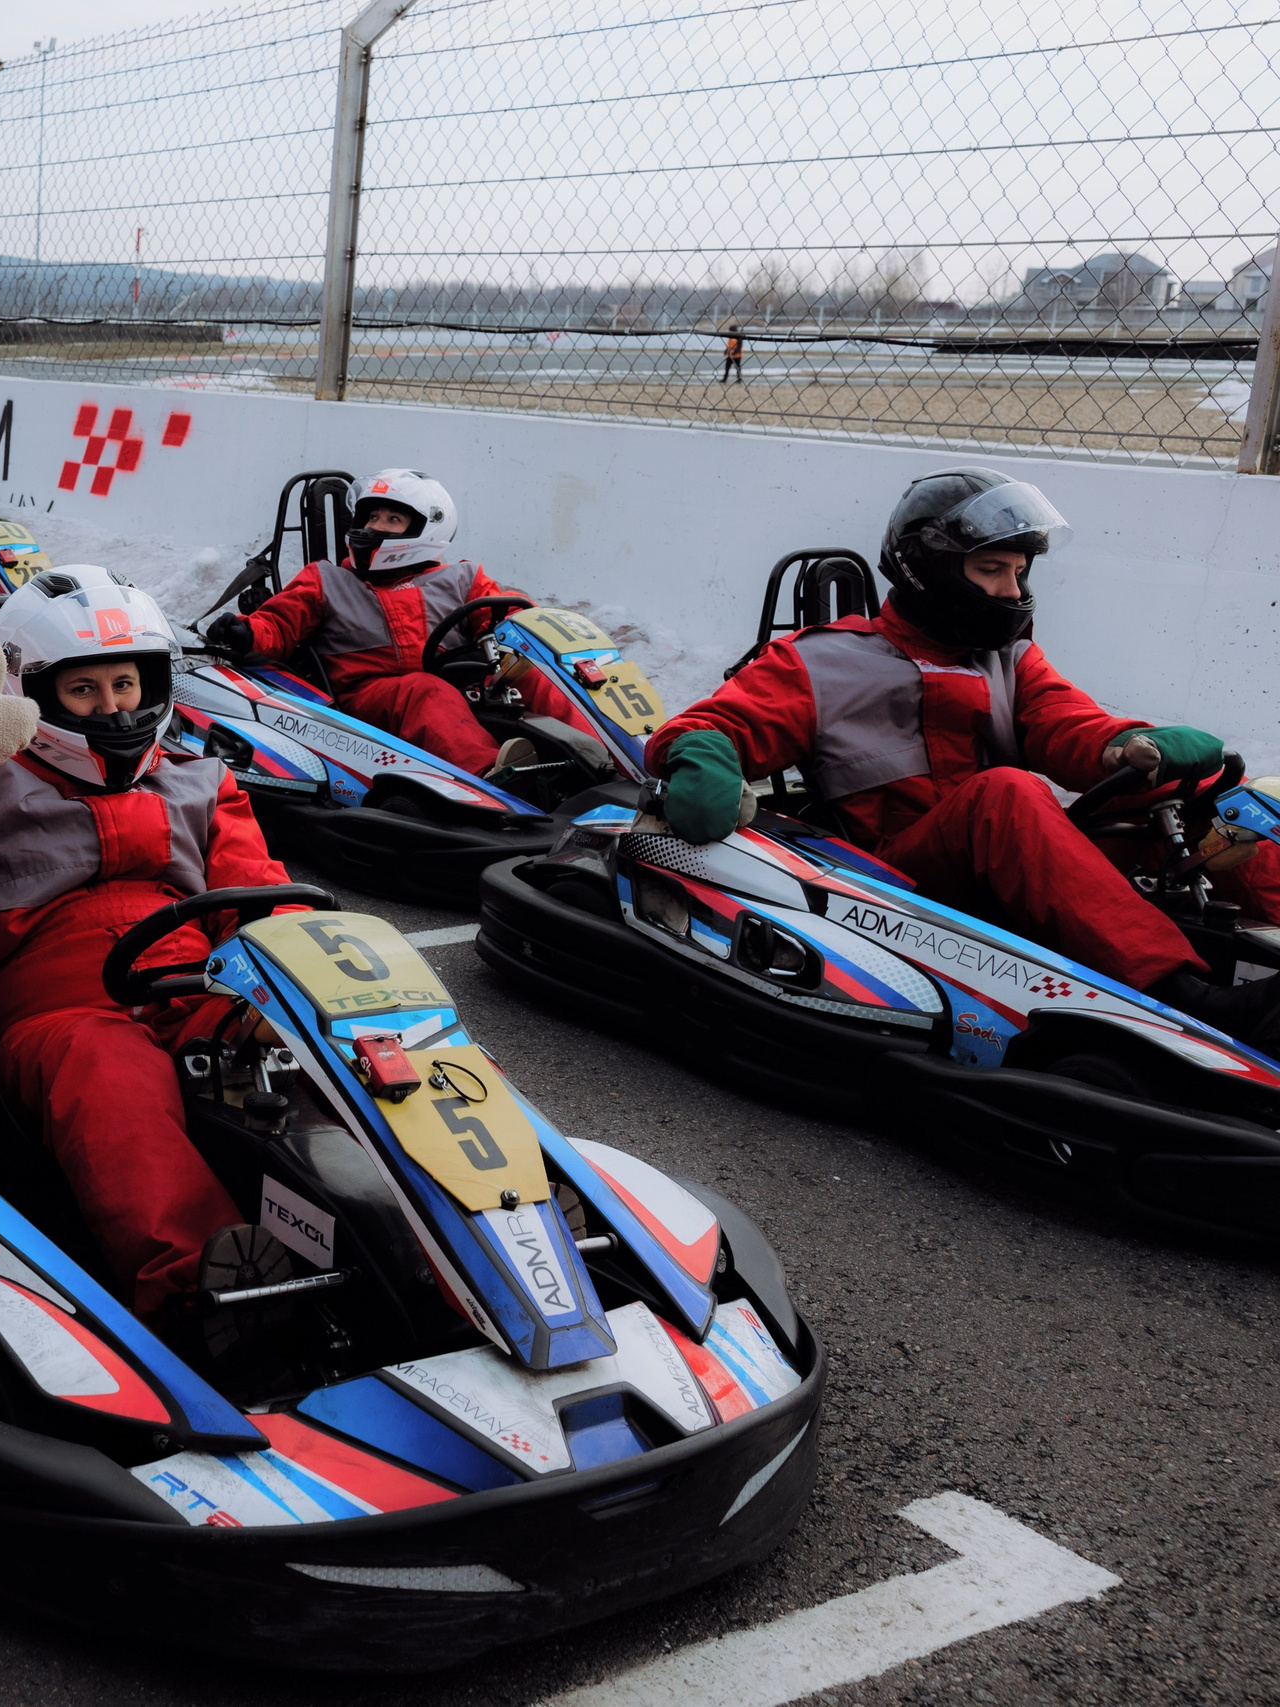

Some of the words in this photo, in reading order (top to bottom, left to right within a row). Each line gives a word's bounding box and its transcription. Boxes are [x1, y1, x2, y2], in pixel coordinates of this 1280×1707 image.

[535, 613, 596, 642] 15
[604, 683, 654, 719] 15
[274, 714, 382, 761] ADMRACEWAY
[297, 919, 390, 982] 5
[841, 905, 1042, 988] ADMRACEWAY
[955, 1013, 1002, 1051] Sodi
[431, 1096, 508, 1171] 5
[634, 1308, 705, 1418] ADMRACEWAY
